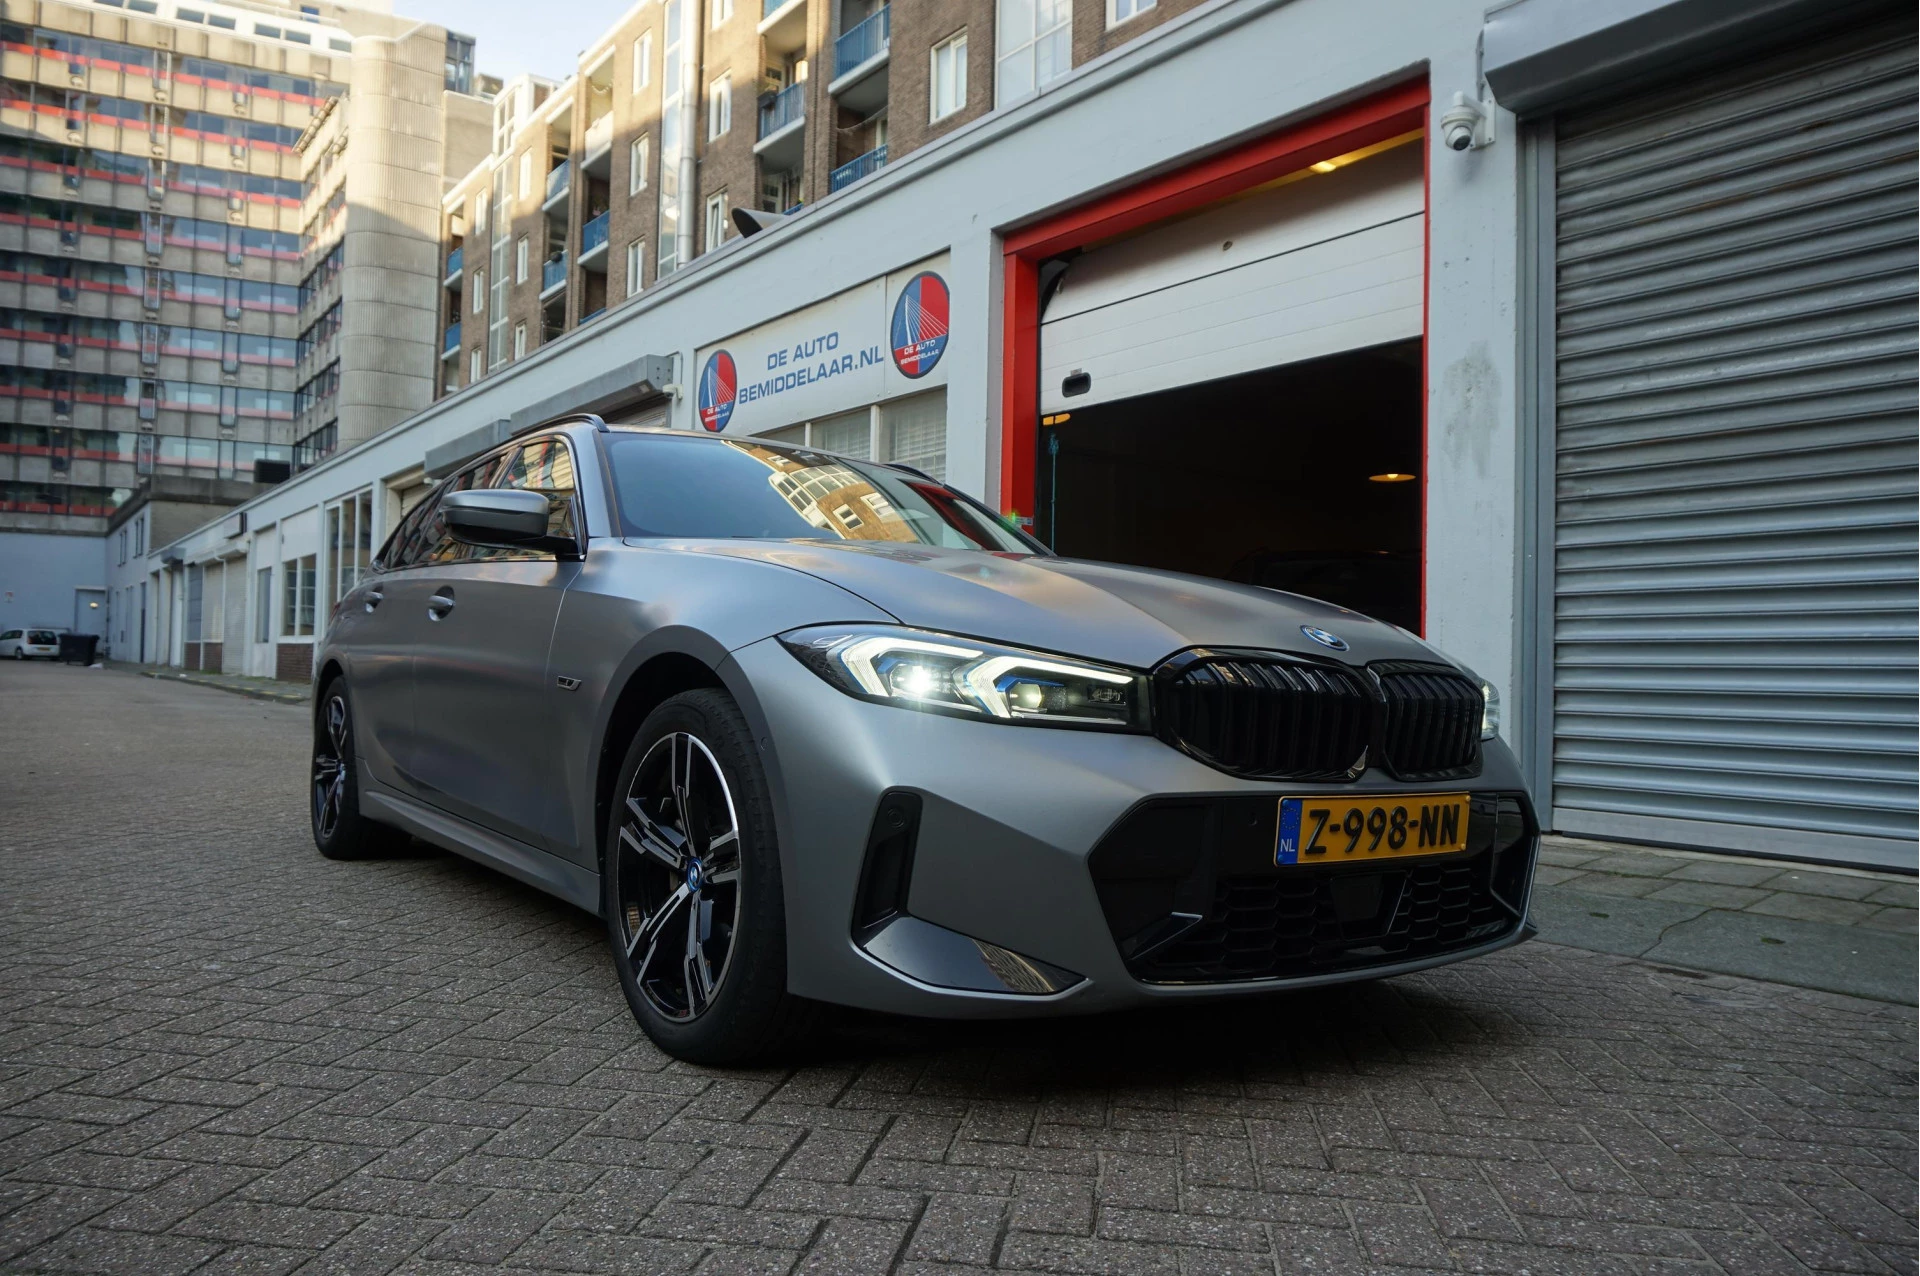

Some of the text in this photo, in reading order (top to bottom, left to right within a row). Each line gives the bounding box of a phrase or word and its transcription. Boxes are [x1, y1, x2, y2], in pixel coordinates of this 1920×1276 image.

[768, 331, 839, 370] DE AUTO
[904, 340, 936, 355] DE AUTO
[739, 346, 884, 404] BEMIDDELAAR.NL
[1280, 839, 1295, 852] NL
[1305, 804, 1460, 854] Z-998-NN
